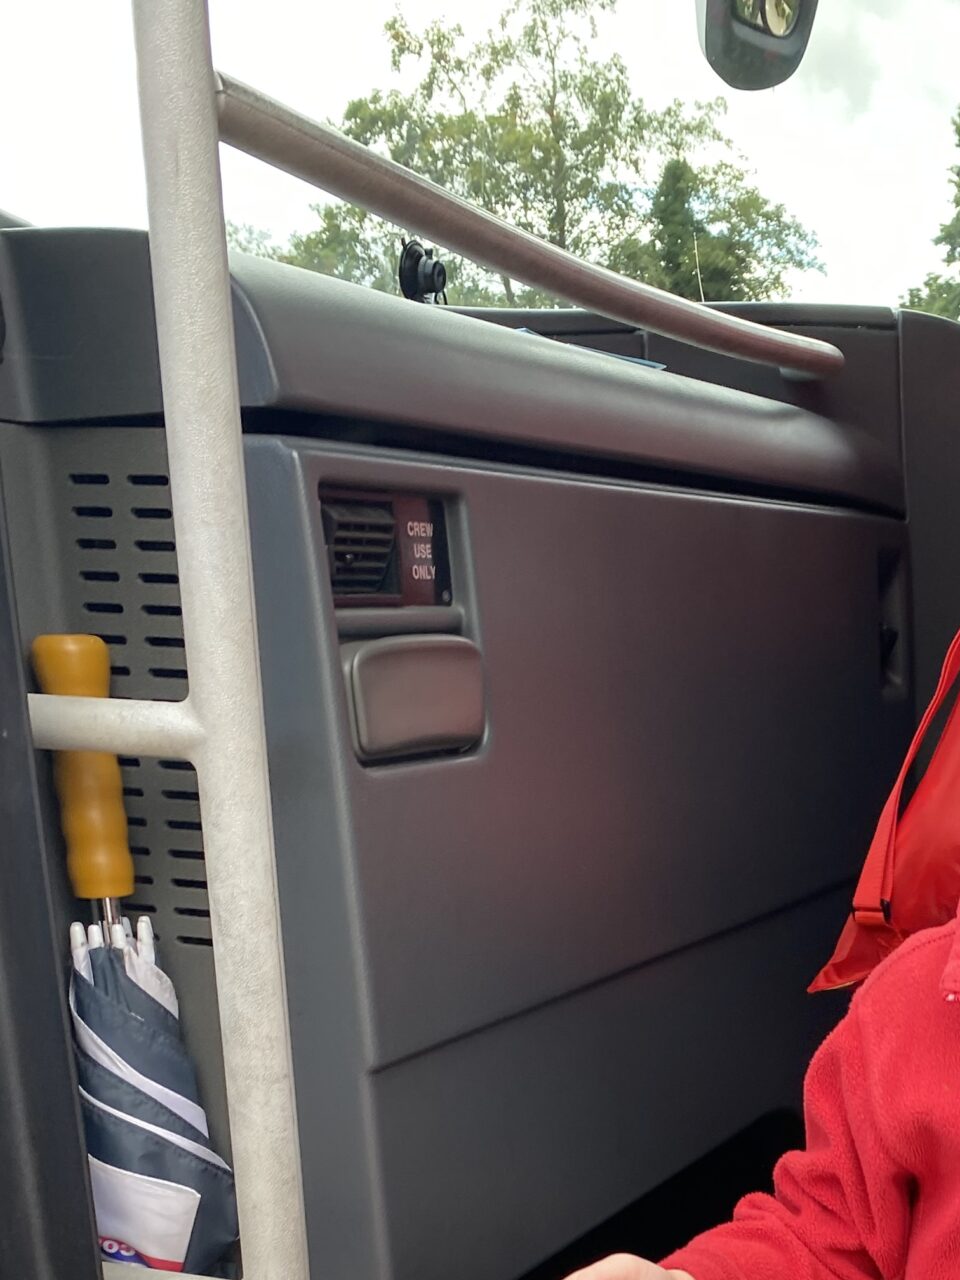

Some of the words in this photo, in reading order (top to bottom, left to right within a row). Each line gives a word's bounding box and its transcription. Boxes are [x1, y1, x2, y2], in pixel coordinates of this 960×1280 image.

[407, 521, 433, 537] CREW
[414, 544, 432, 559] USE
[412, 564, 436, 580] ONLY
